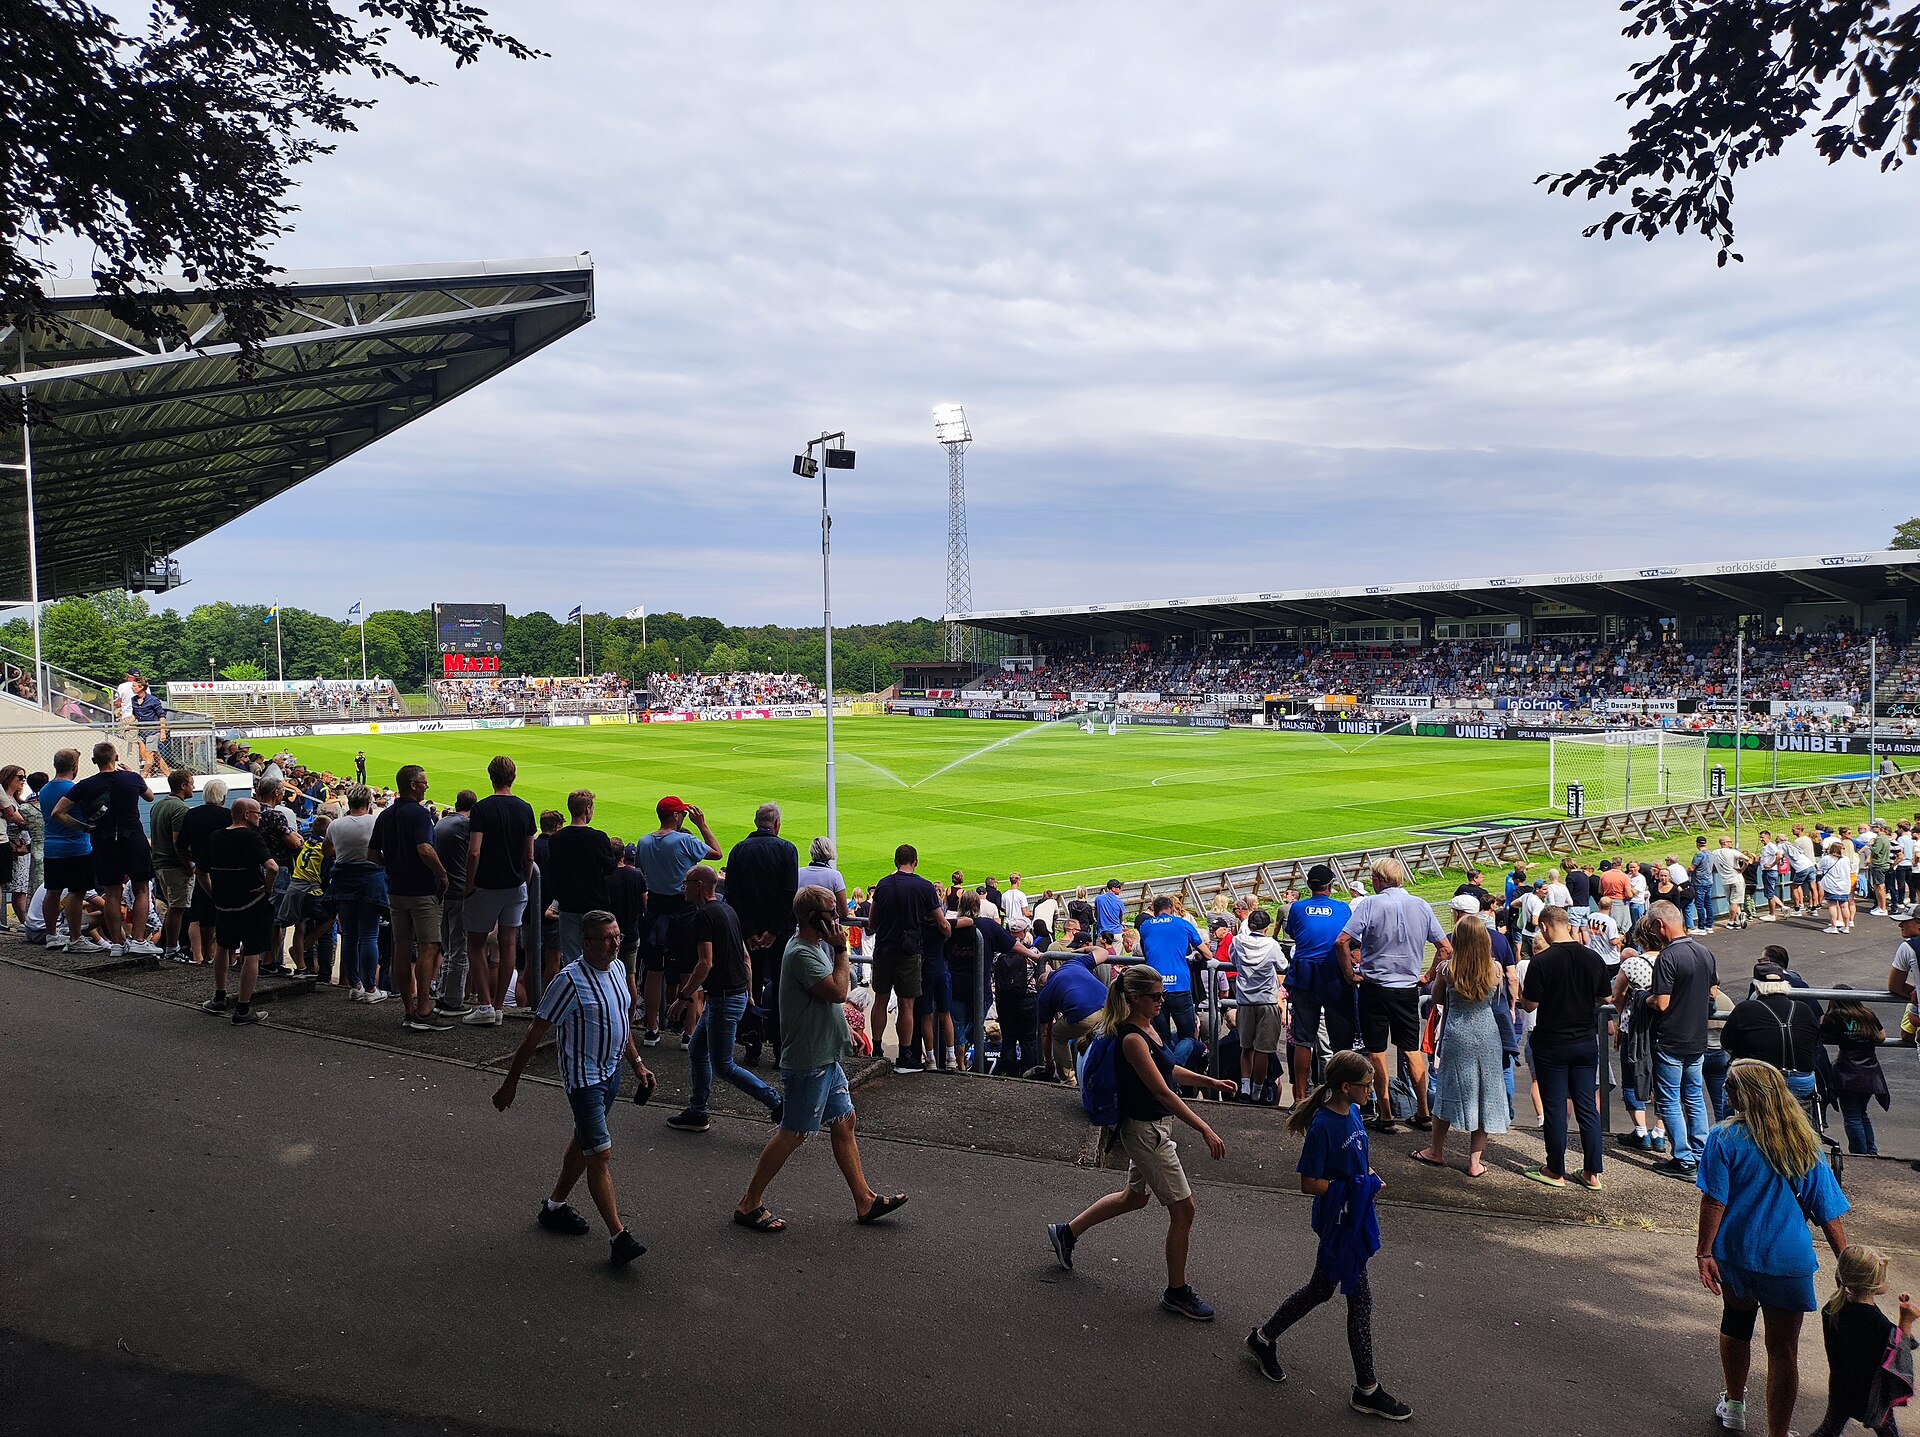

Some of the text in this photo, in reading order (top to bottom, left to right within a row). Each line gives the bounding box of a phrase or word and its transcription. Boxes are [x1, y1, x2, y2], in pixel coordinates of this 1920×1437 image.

[1716, 561, 1777, 573] storköksidé
[1553, 572, 1603, 584] storköksidé
[1418, 582, 1460, 592] storköksidé
[1304, 589, 1341, 598] storköksidé
[1207, 596, 1238, 604] storköksidé
[174, 684, 190, 692] WE
[1371, 696, 1406, 706] SVENSKA
[1408, 697, 1428, 707] LYFT
[1660, 702, 1675, 710] VVS
[700, 712, 729, 721] BYGG
[914, 708, 935, 717] UNIBET
[968, 709, 992, 719] UNIBET
[1033, 711, 1060, 721] UNIBET
[600, 714, 625, 722] HYLTE
[245, 725, 296, 738] villalivet
[383, 724, 399, 732] Bygg
[399, 723, 411, 731] Syd
[1338, 722, 1382, 734] UNIBET
[1517, 730, 1534, 738] SPELA
[1776, 735, 1851, 753] UNIBET
[1866, 743, 1893, 752] SPELA
[1308, 907, 1330, 915] EAB
[987, 1057, 998, 1075] 7
